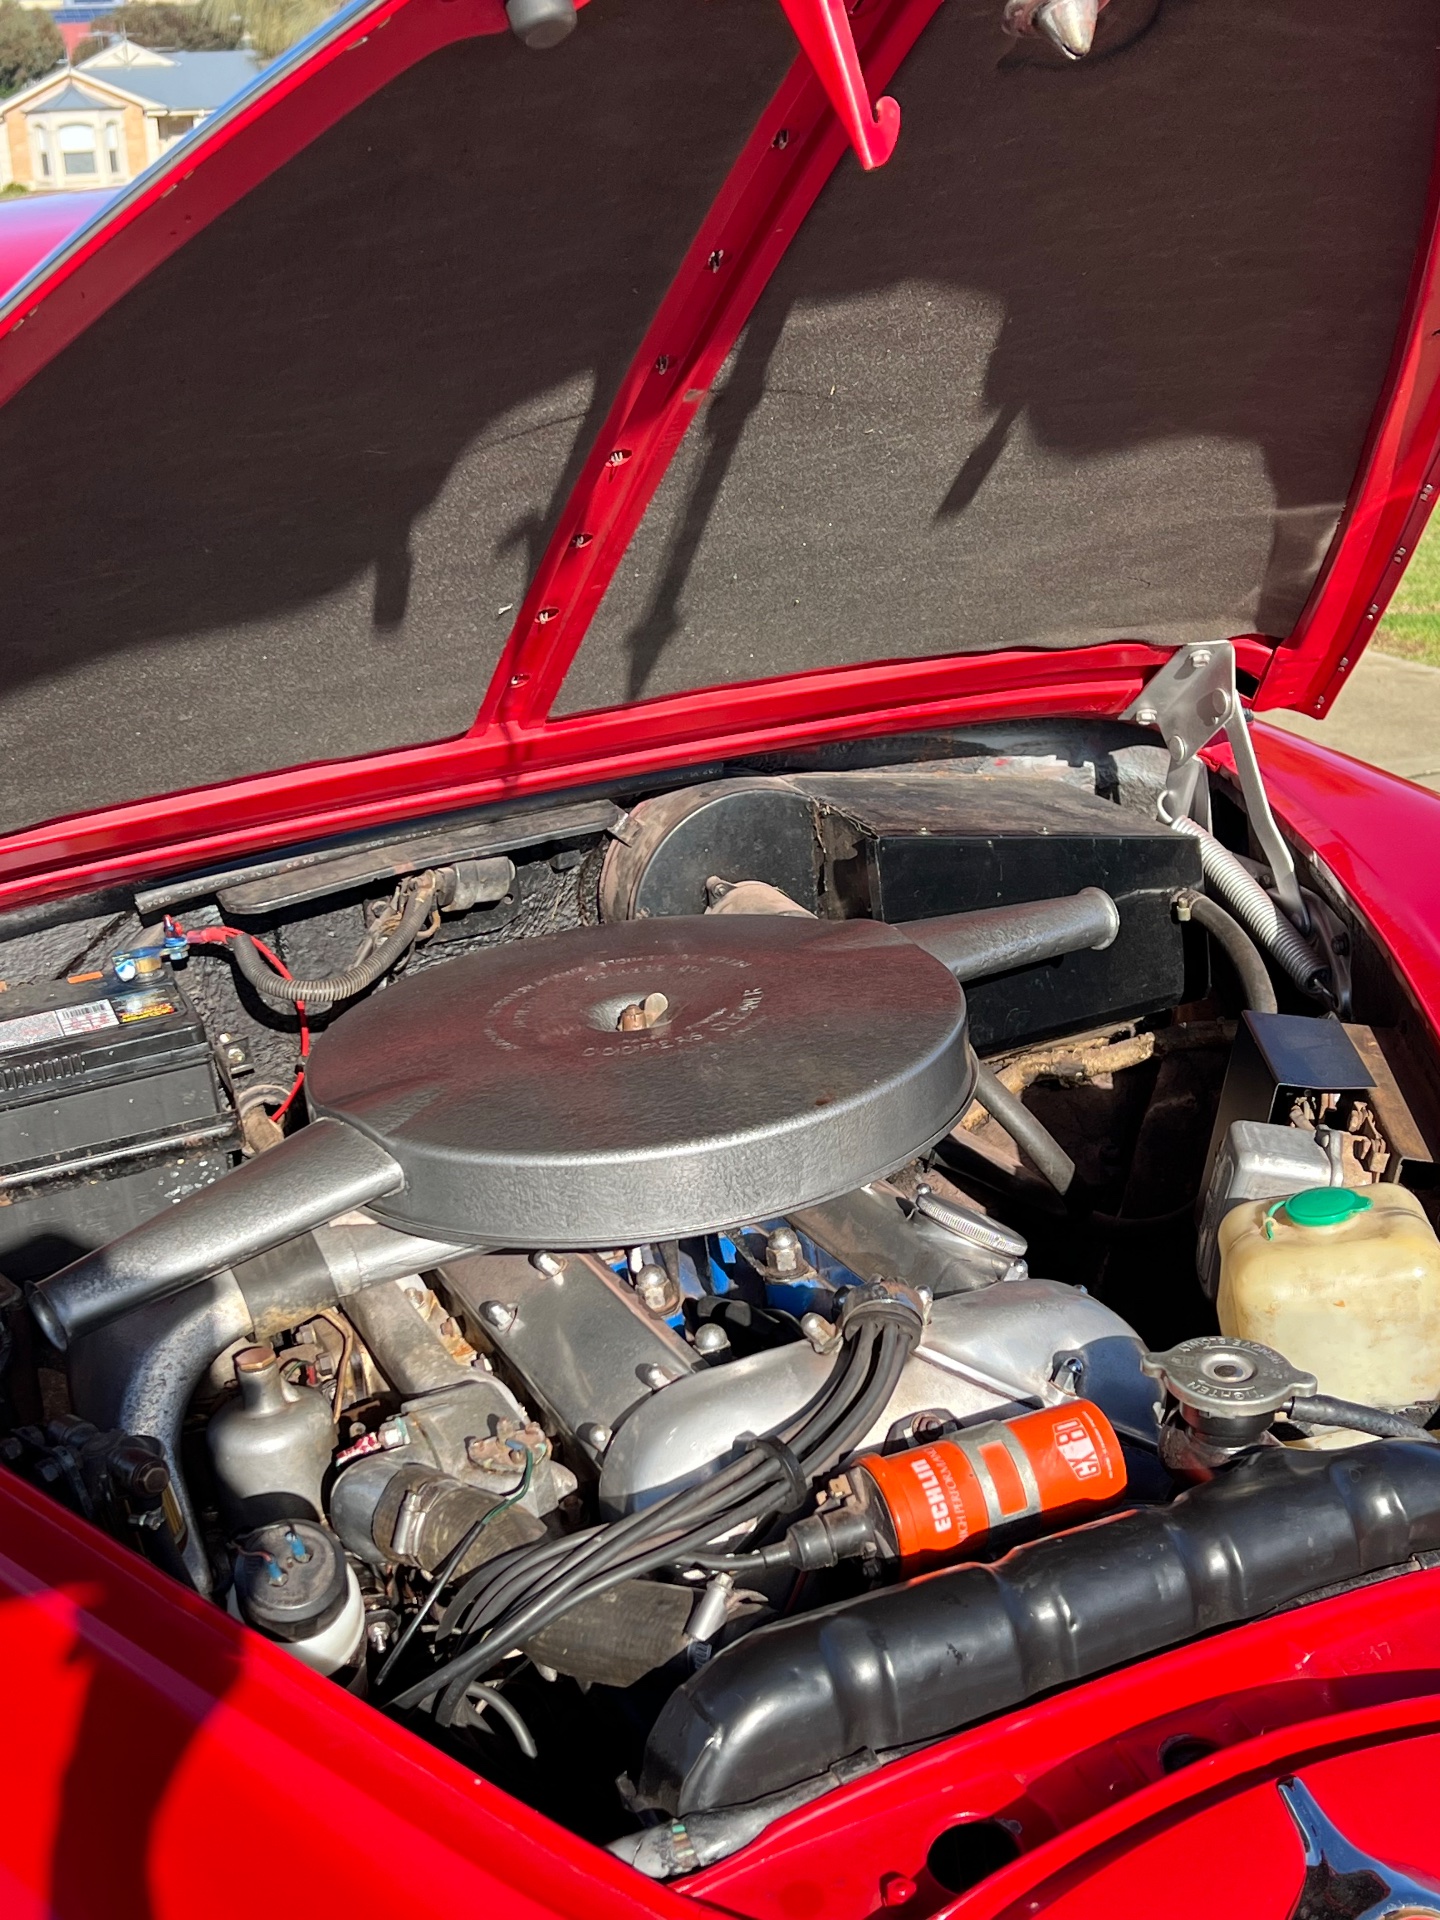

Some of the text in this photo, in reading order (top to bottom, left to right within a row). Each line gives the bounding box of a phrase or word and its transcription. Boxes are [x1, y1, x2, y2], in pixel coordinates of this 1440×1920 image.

[581, 1031, 704, 1057] COOPERS
[1232, 1337, 1285, 1365] REMOVE
[1186, 1380, 1265, 1401] TIGHTEN
[924, 1446, 965, 1514] PERFORMANC
[911, 1458, 952, 1533] ECHLIN
